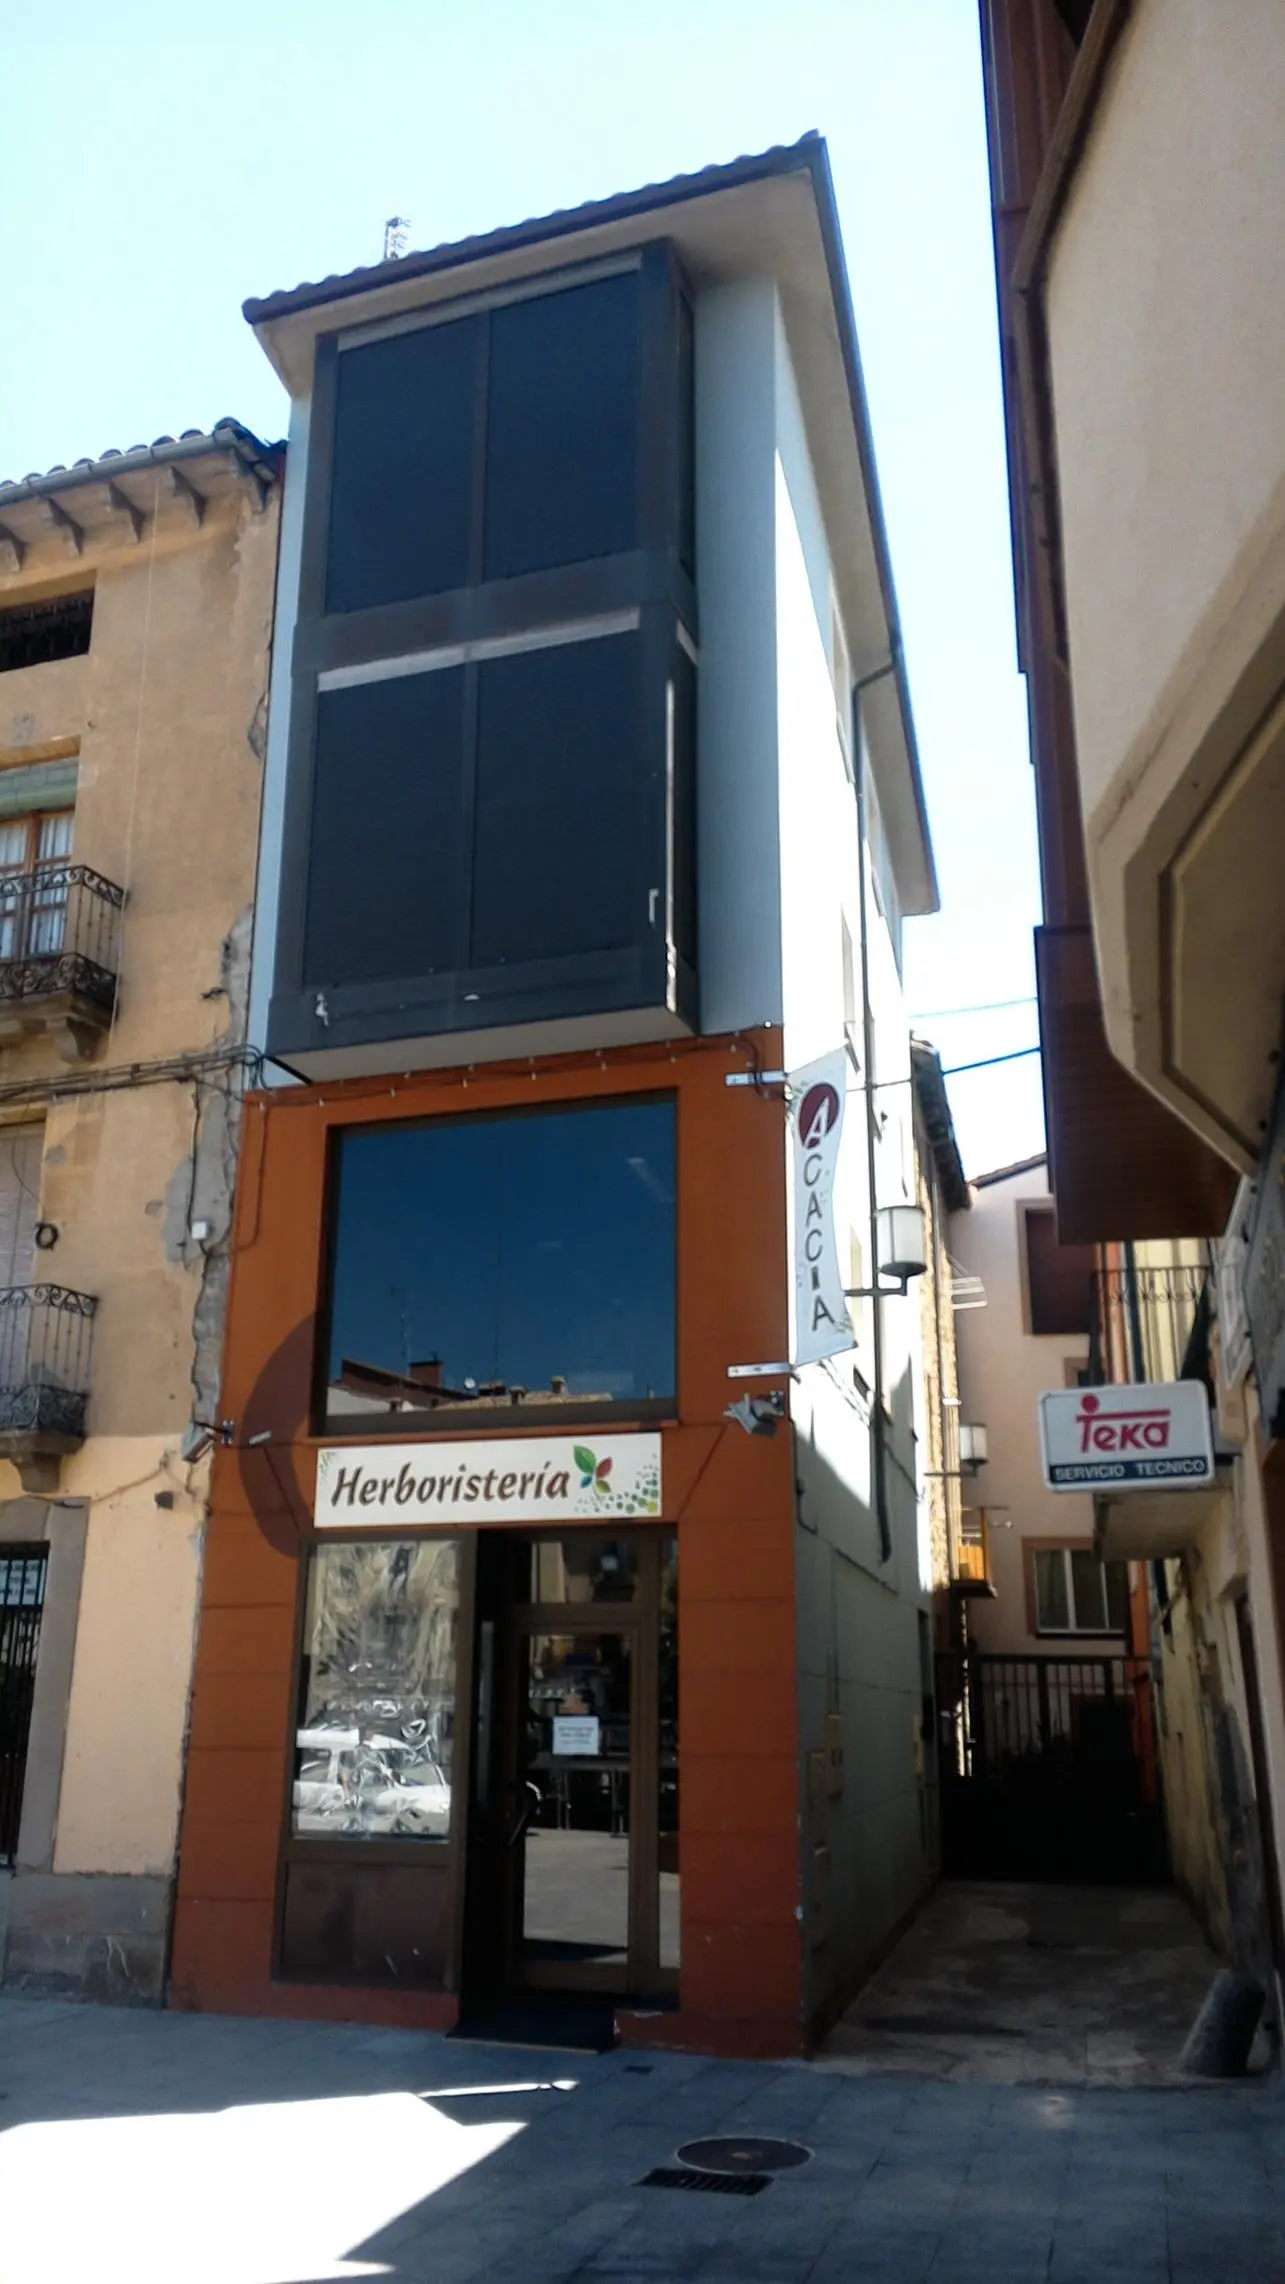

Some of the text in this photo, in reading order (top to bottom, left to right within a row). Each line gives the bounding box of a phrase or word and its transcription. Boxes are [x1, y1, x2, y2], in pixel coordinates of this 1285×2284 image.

[800, 1094, 837, 1332] ACACIA
[331, 1461, 570, 1507] Herboristería
[1055, 1459, 1206, 1482] SERVICIO TECNICO
